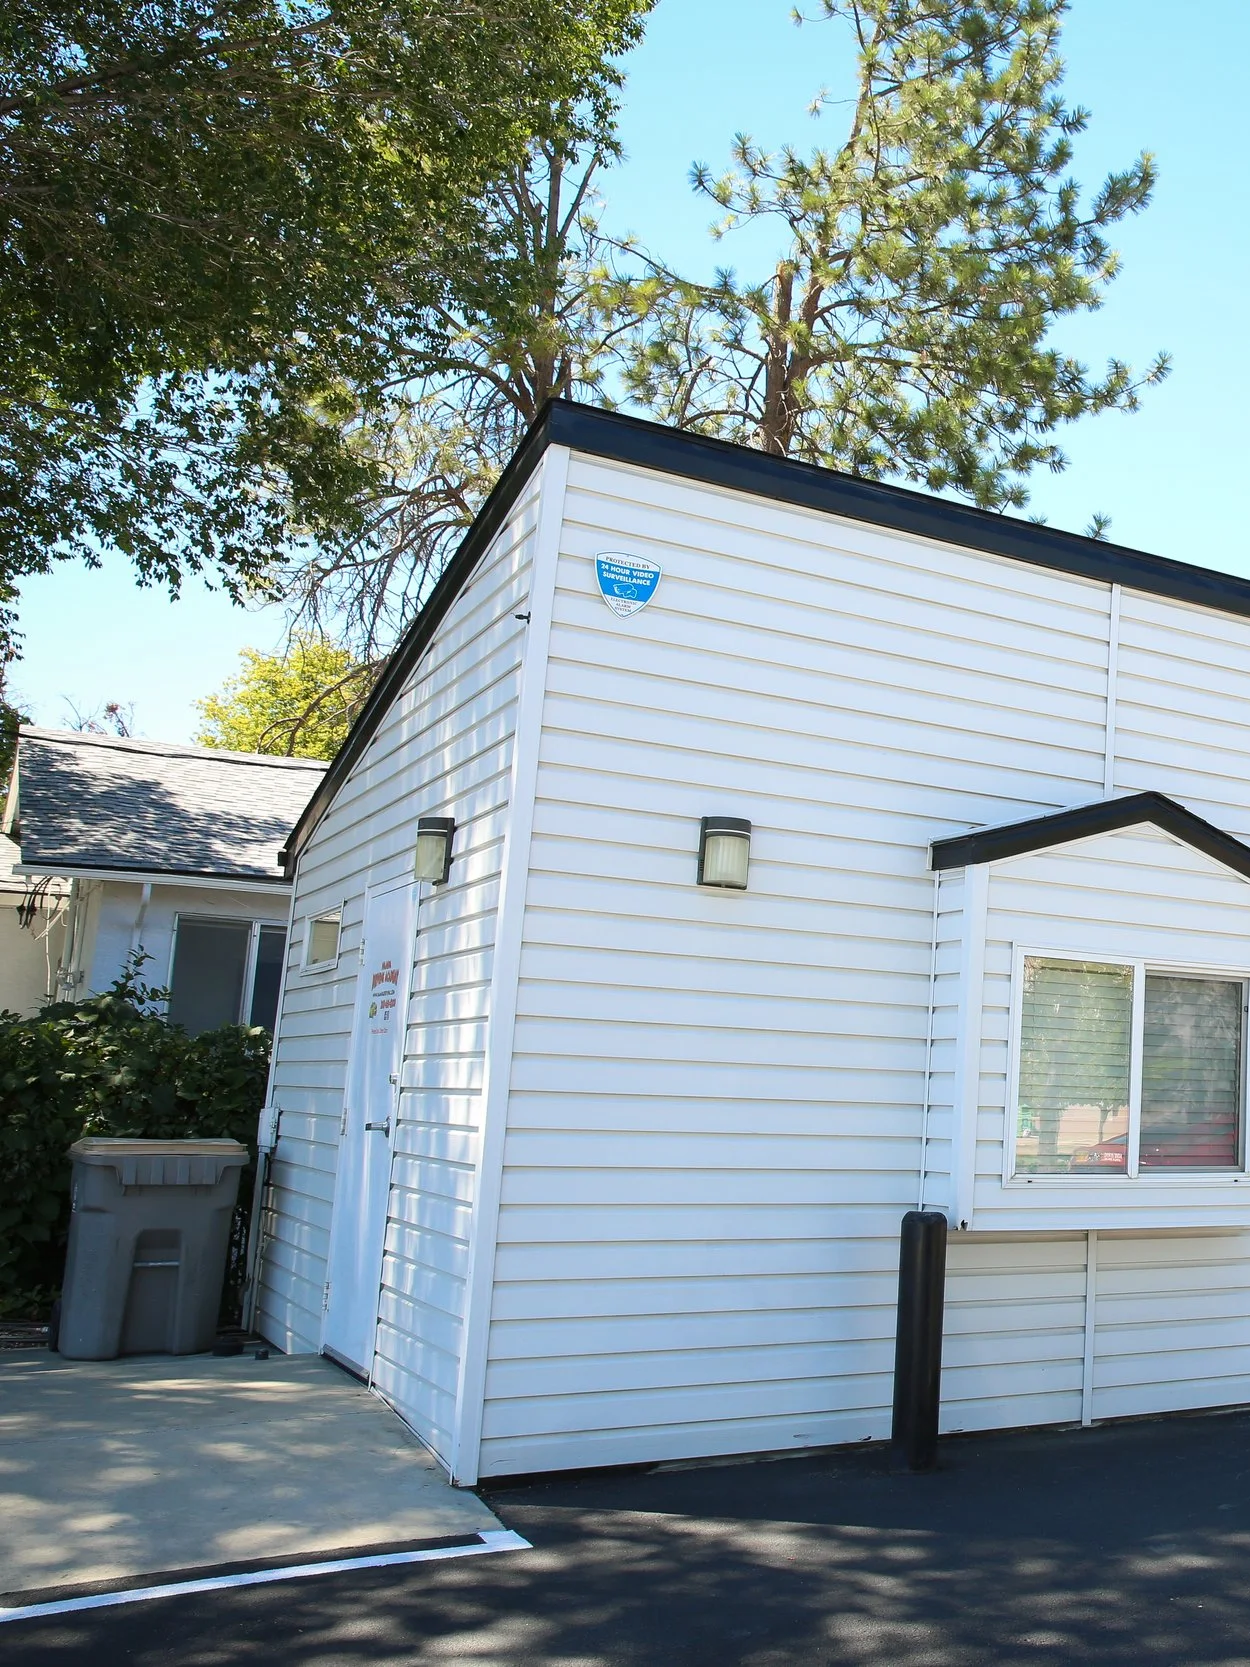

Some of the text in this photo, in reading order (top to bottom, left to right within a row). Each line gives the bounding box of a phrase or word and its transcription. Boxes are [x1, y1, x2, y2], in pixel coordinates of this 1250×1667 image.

[605, 556, 640, 569] PROTECTED
[602, 571, 651, 586] SURVEILLANCE
[610, 565, 630, 575] HOUR
[632, 570, 654, 579] VIDEO
